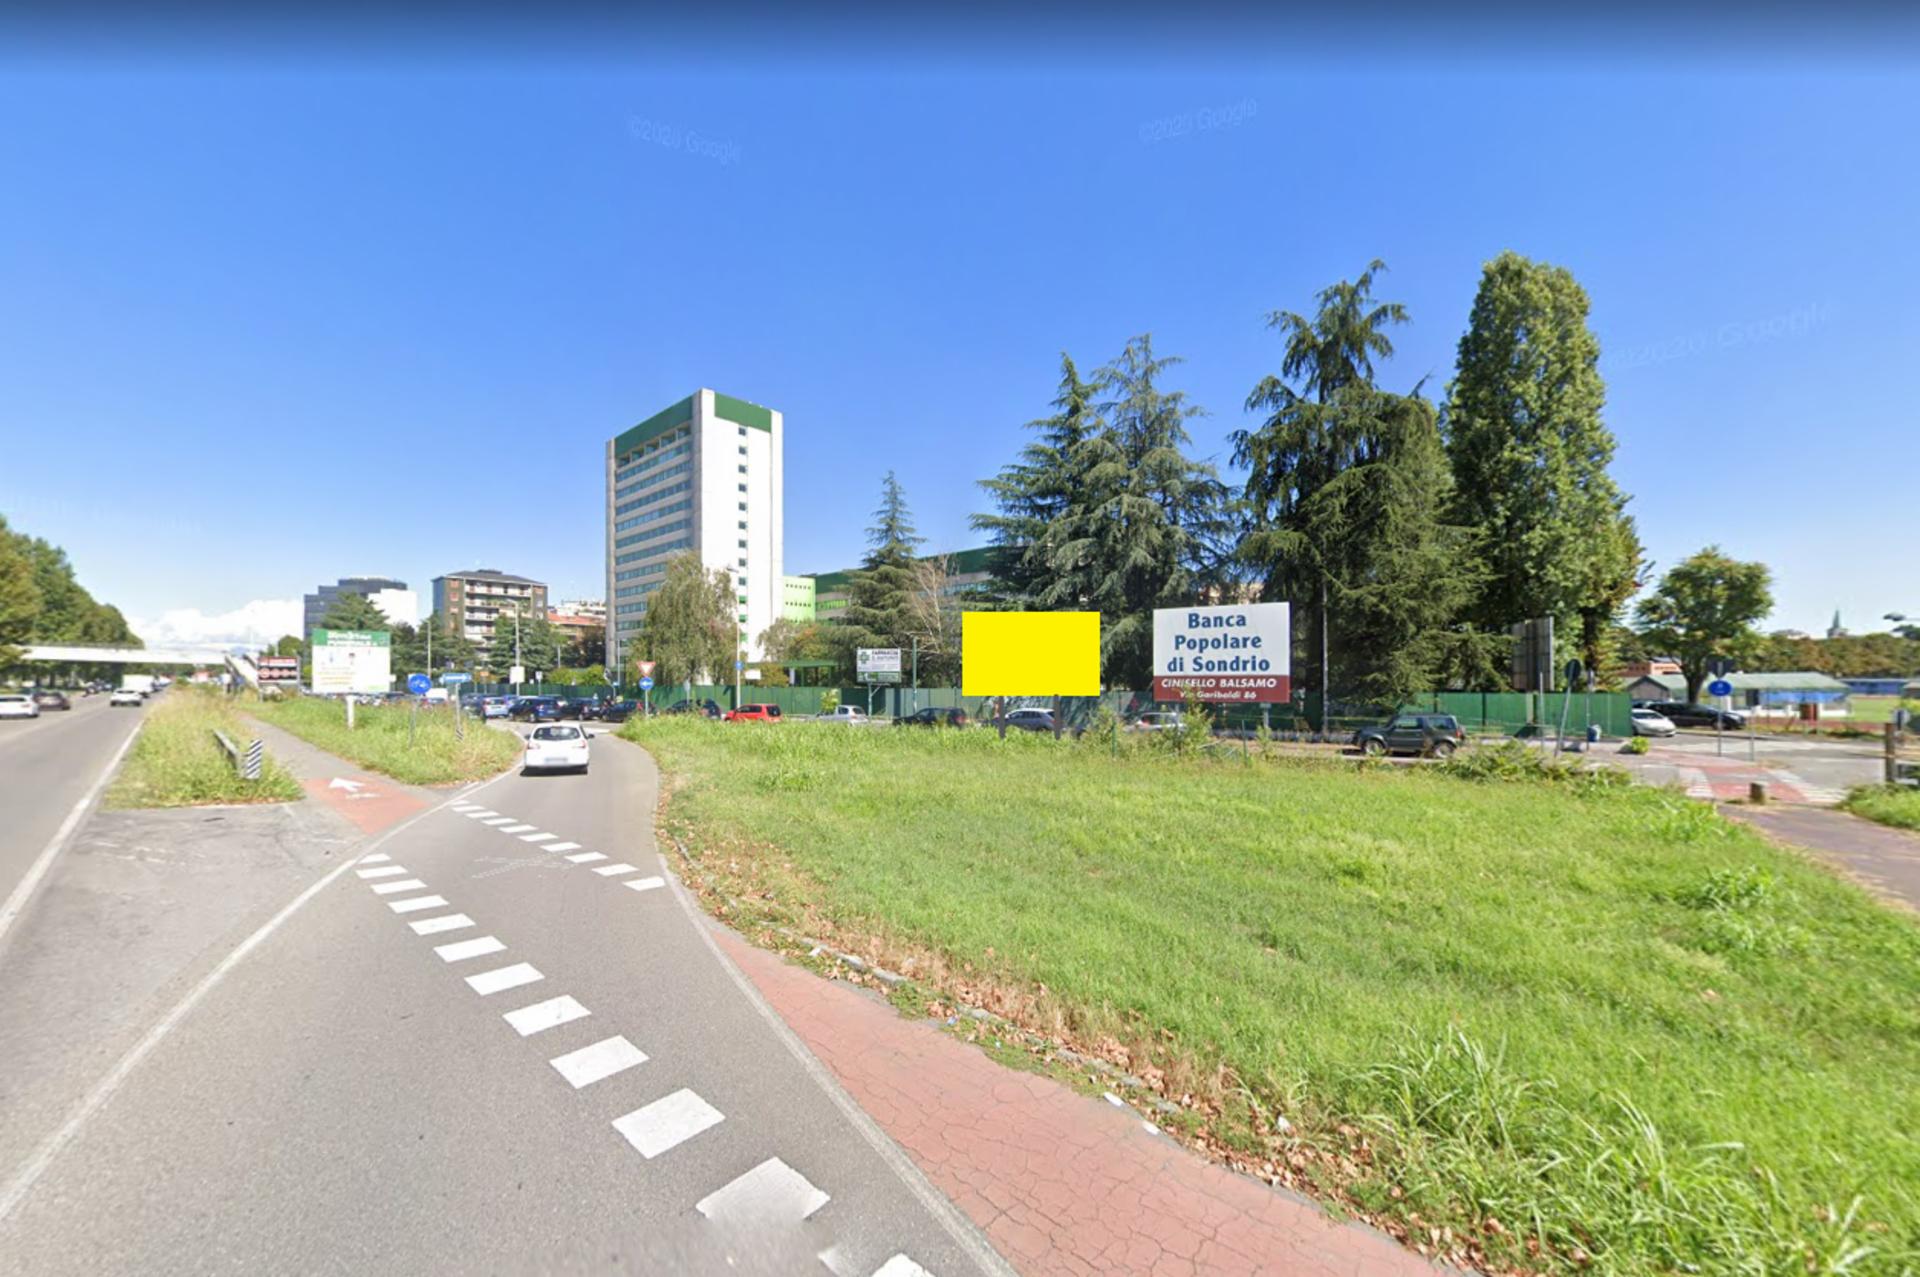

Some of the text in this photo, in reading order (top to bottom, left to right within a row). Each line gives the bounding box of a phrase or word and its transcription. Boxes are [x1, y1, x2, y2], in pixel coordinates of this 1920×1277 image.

[1188, 612, 1247, 629] Banca
[1174, 633, 1262, 653] Popolare
[1167, 655, 1271, 673] di Sondrio
[1220, 678, 1278, 688] BALSAMO
[1197, 690, 1241, 699] Garibaldi
